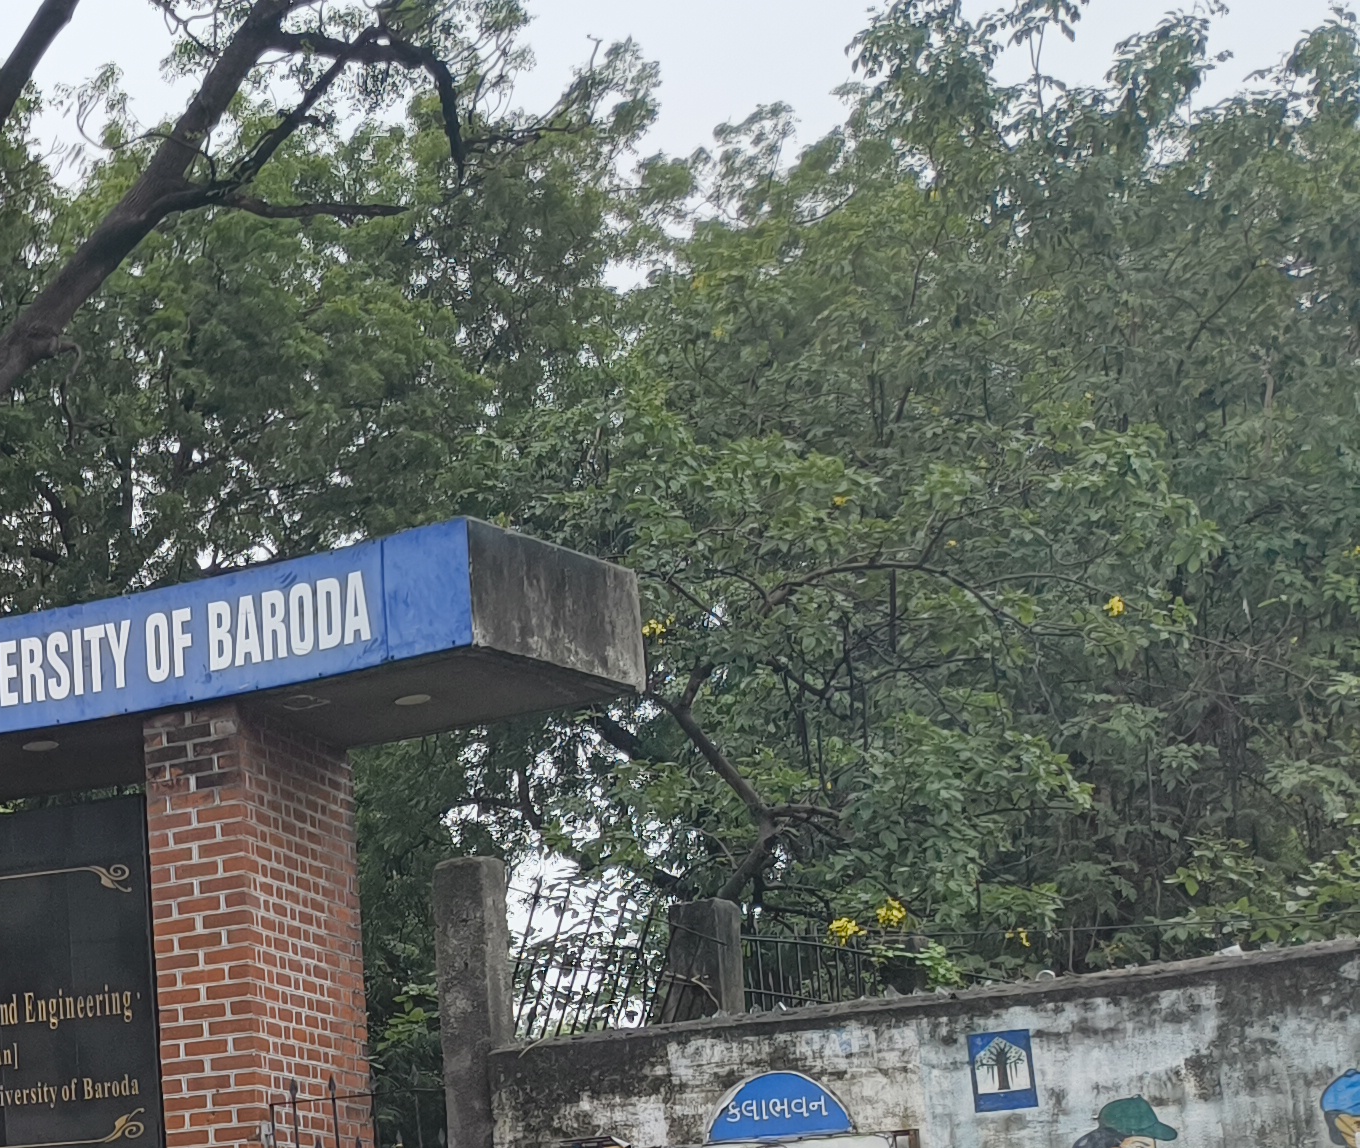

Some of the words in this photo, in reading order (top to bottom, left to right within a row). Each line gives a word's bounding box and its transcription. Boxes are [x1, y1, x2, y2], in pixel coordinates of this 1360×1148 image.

[145, 607, 192, 683] OF
[207, 570, 372, 672] BARODA
[24, 984, 133, 1030] Engineering
[61, 1078, 78, 1102] of
[83, 1074, 140, 1100] Baroda
[726, 1095, 828, 1122] કલાભવન
